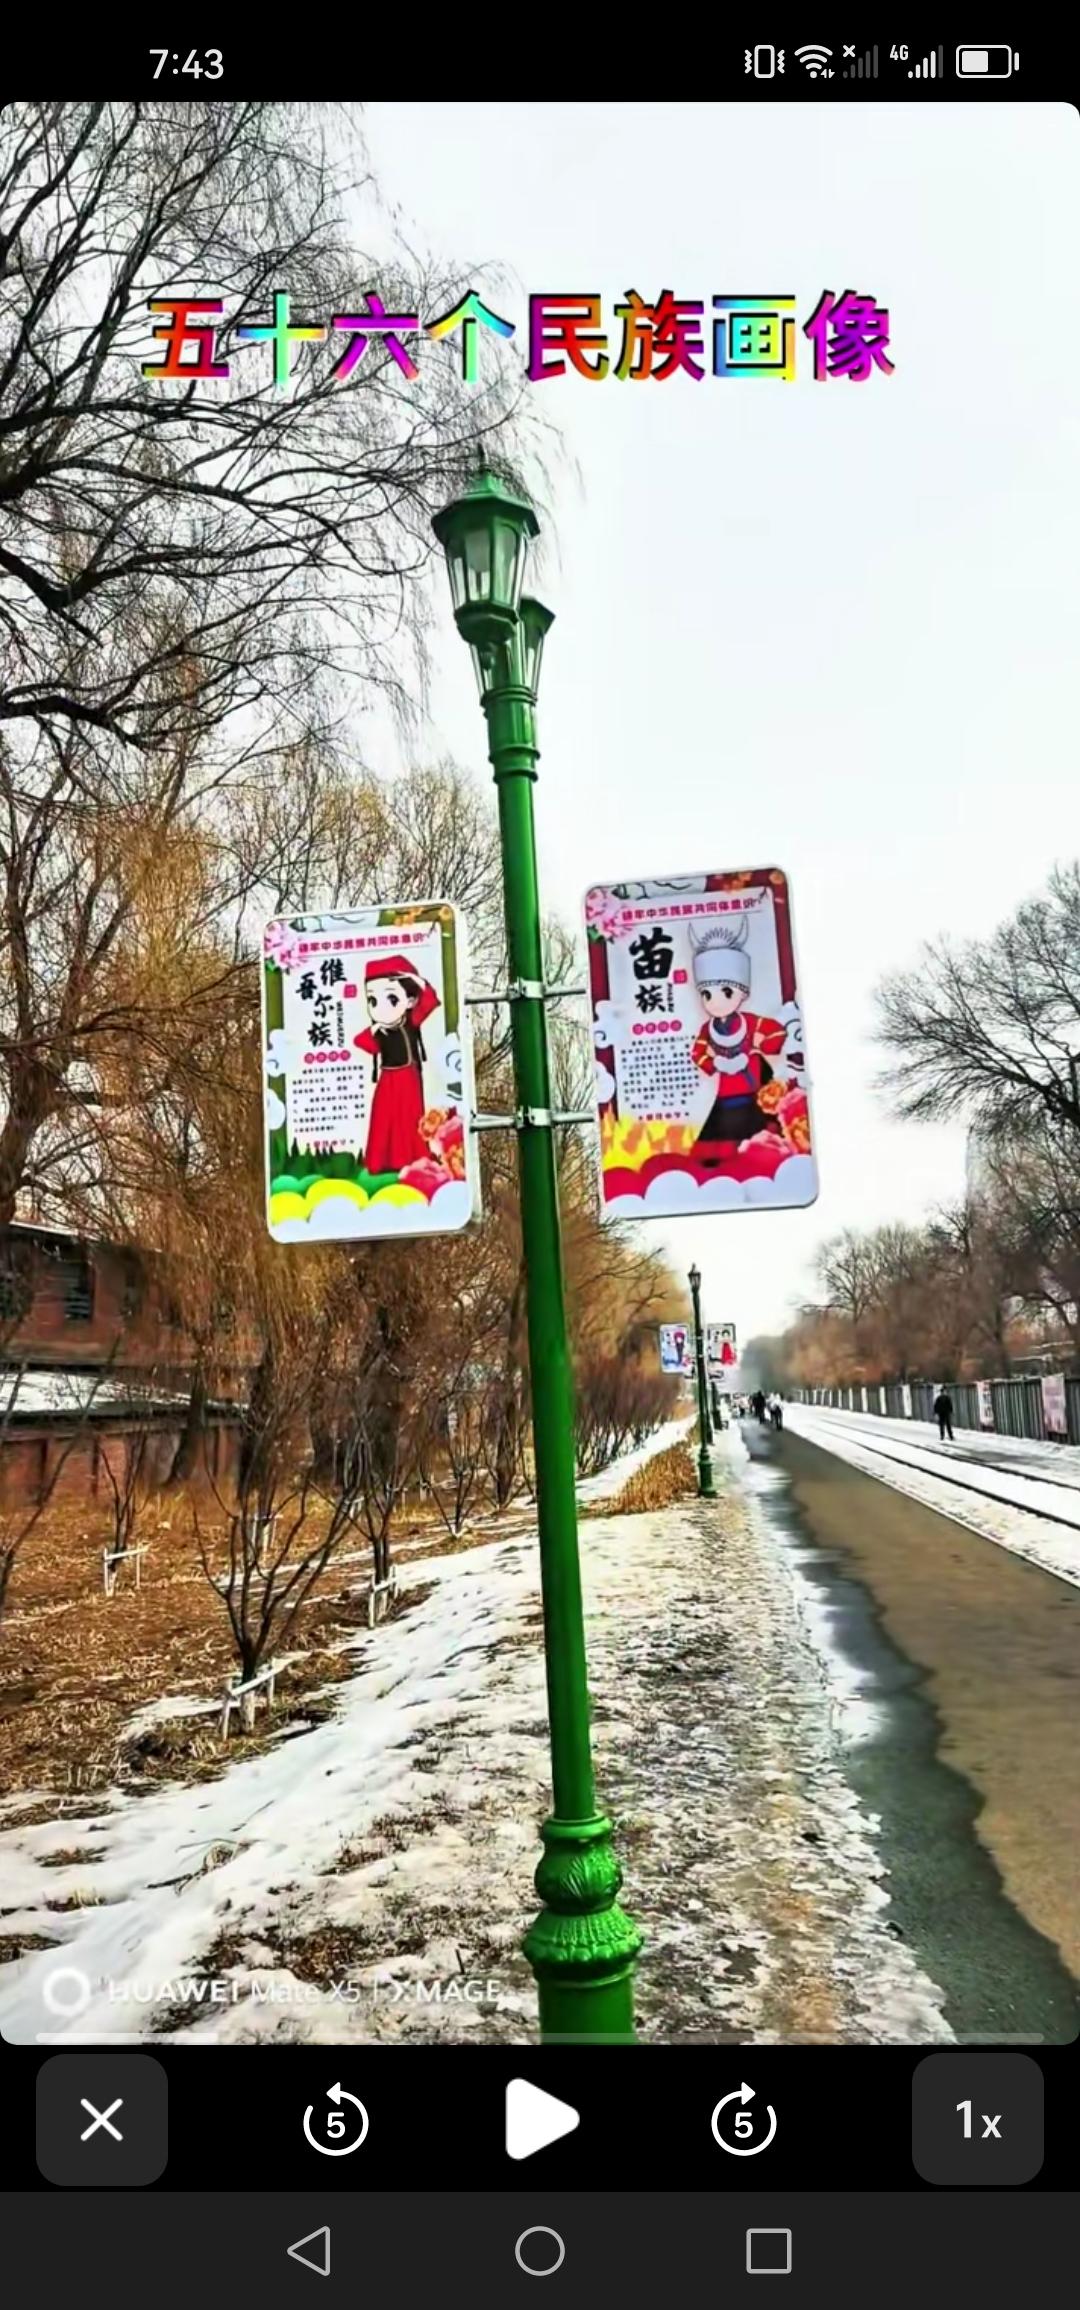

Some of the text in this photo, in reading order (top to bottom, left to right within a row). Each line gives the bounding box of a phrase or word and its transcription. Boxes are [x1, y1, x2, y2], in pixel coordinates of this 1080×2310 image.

[295, 957, 348, 1047] 维吾尔族
[628, 926, 674, 1014] 苗族
